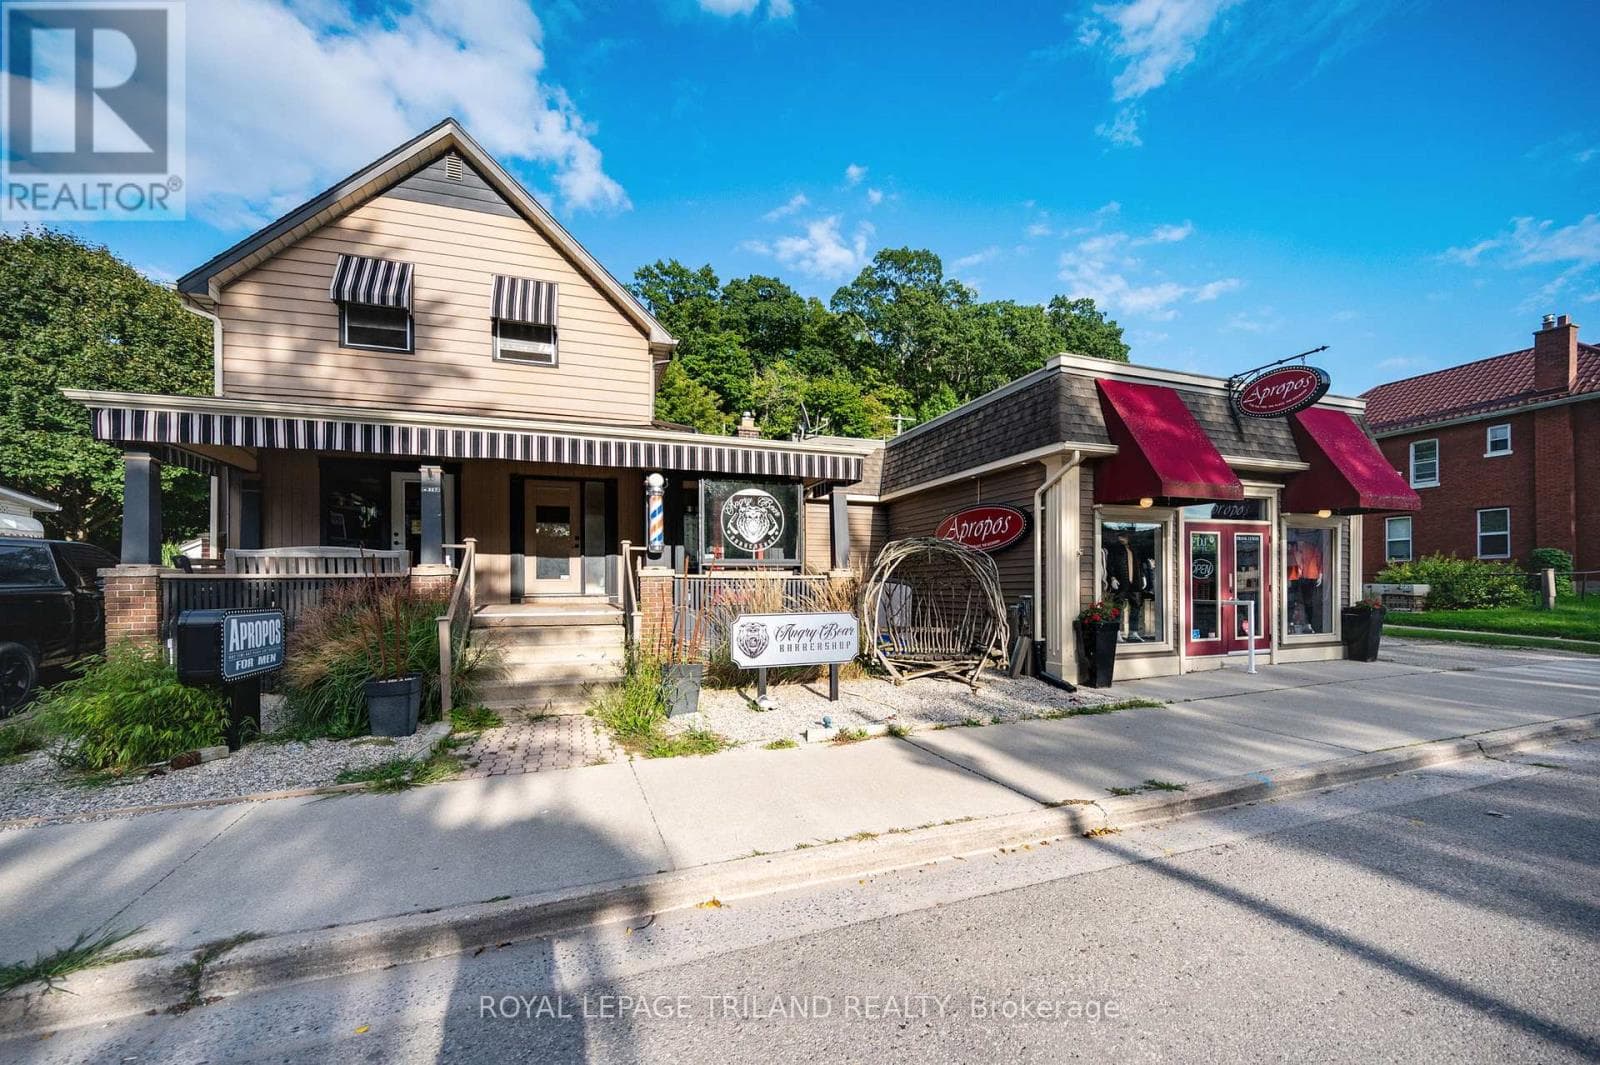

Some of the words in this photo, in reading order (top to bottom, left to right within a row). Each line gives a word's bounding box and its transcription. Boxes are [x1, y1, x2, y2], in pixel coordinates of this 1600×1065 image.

[1243, 376, 1312, 404] Apropos
[942, 515, 1011, 542] Apropos
[774, 623, 817, 642] Angry
[819, 622, 855, 640] Bear
[779, 641, 851, 653] BARBERSHOP
[235, 658, 254, 671] FOR
[257, 653, 277, 665] MEN
